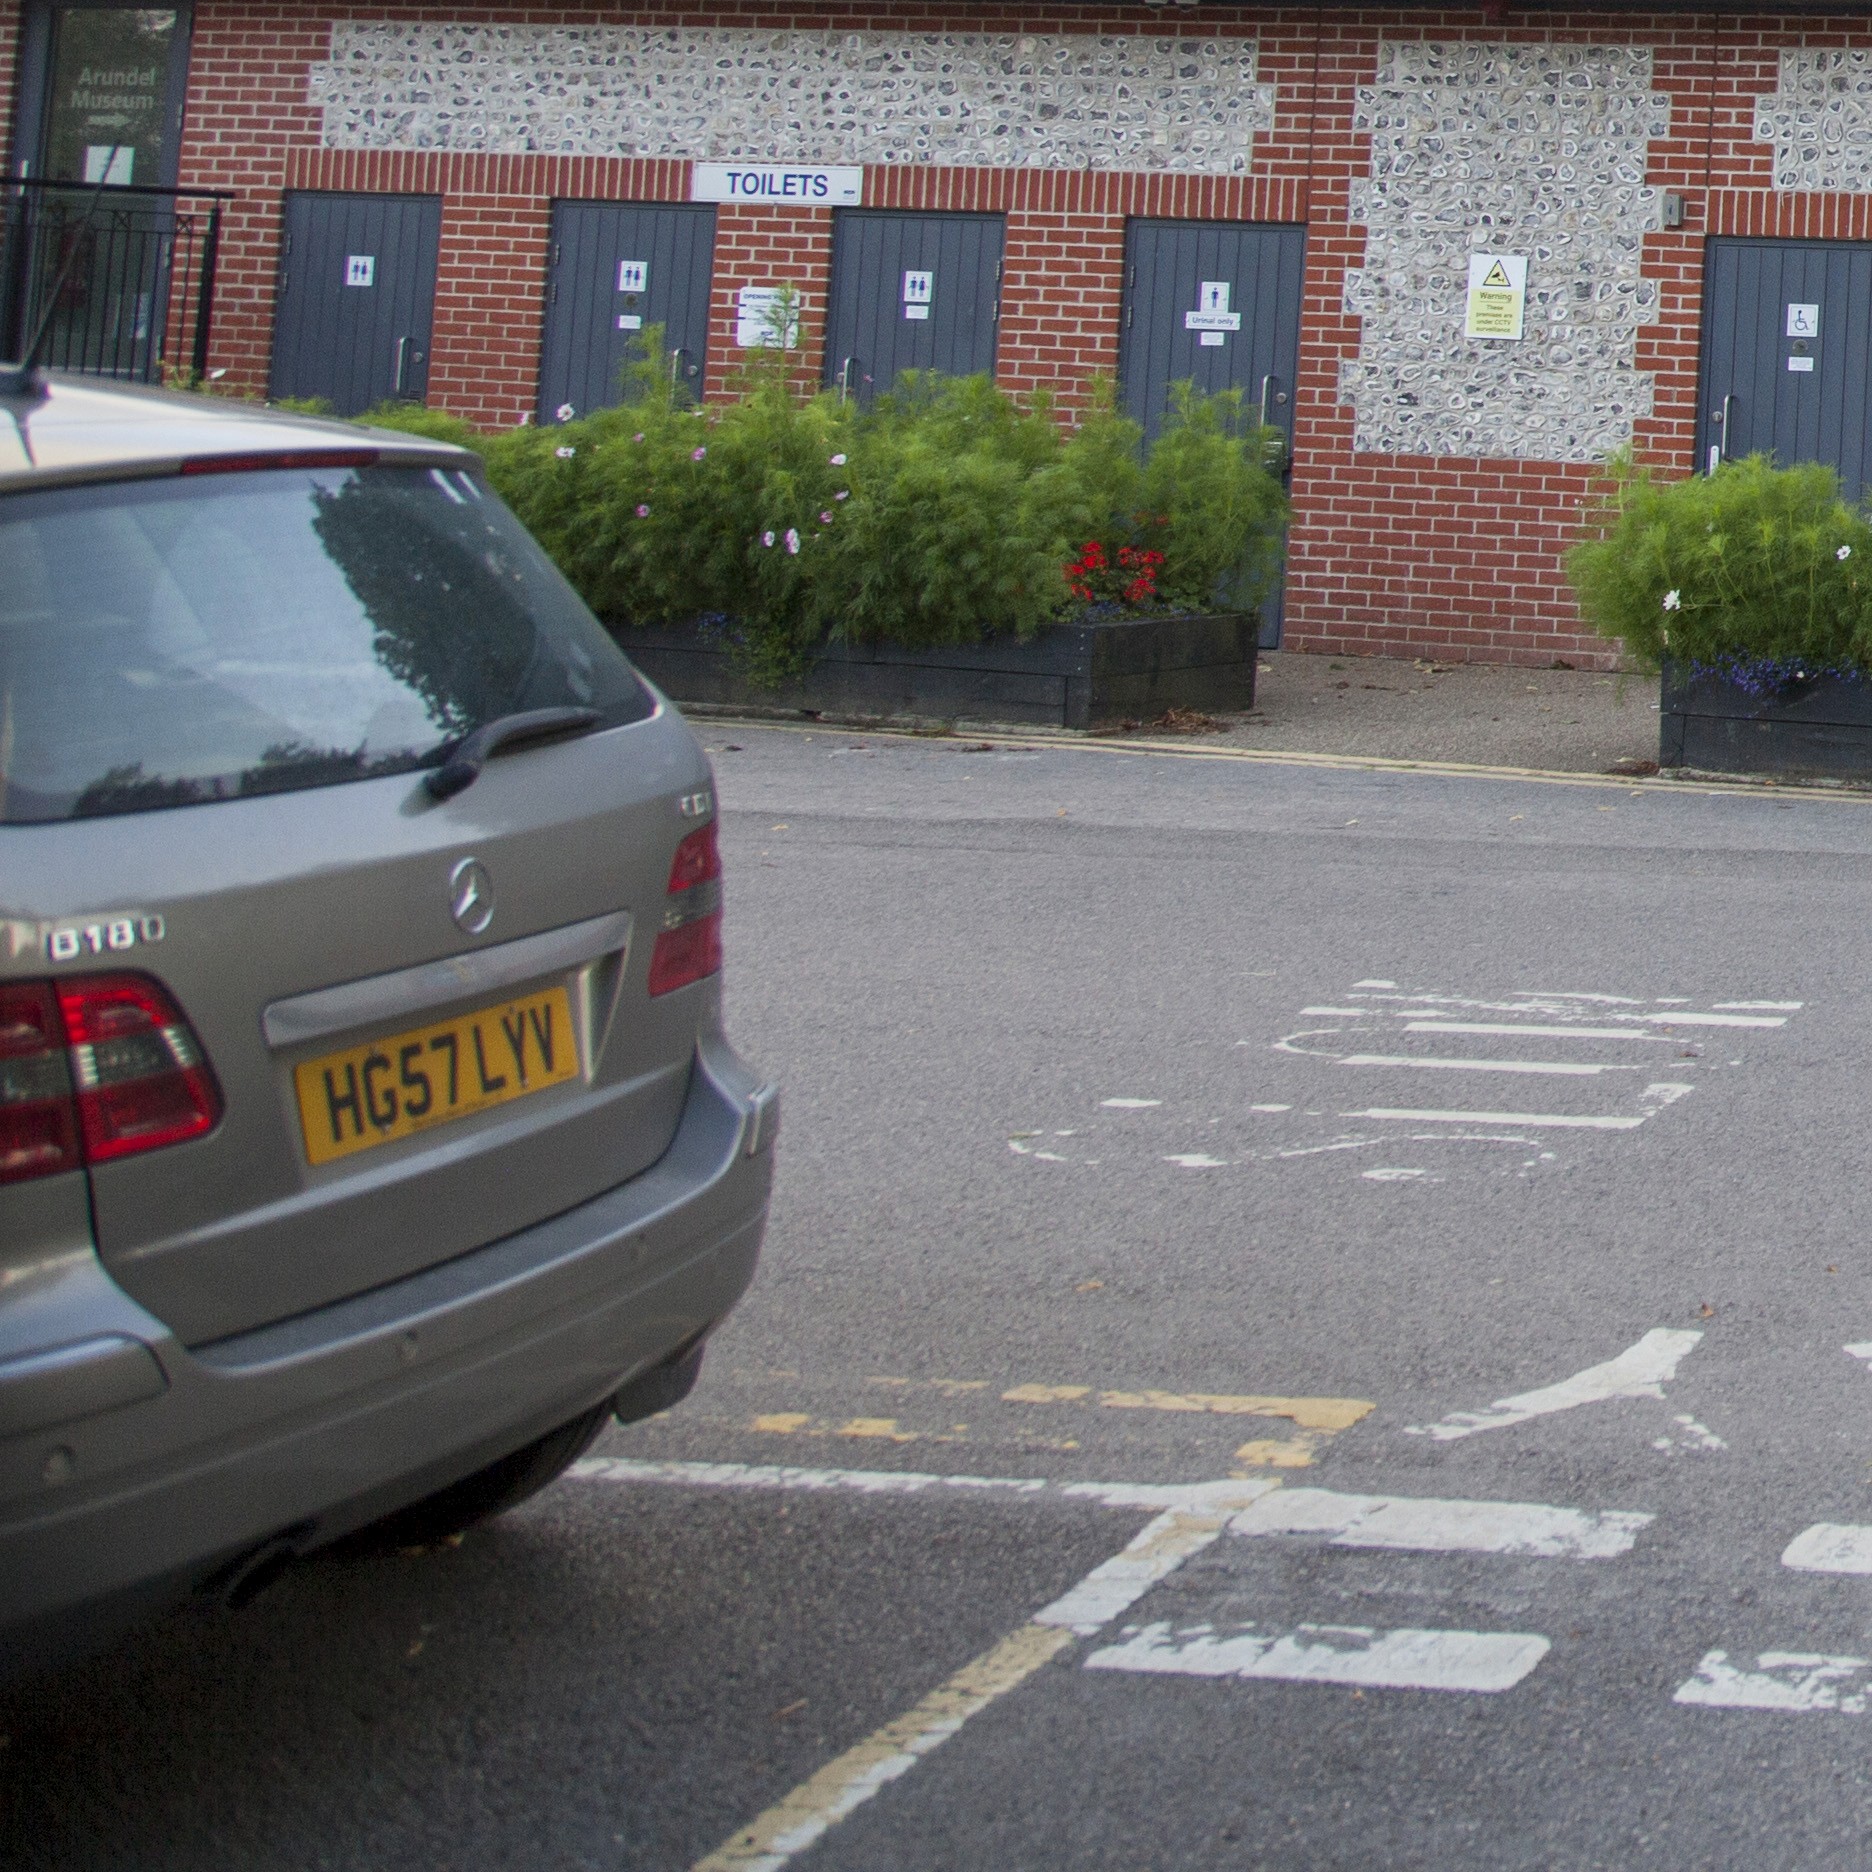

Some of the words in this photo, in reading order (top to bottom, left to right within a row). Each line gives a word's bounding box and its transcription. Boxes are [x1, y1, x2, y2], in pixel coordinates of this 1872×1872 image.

[79, 67, 155, 86] Arundel
[71, 89, 154, 109] Museum
[727, 172, 829, 197] TOILETS
[1480, 292, 1512, 302] Warning
[323, 1031, 457, 1143] HG57
[472, 1002, 555, 1095] LYV
